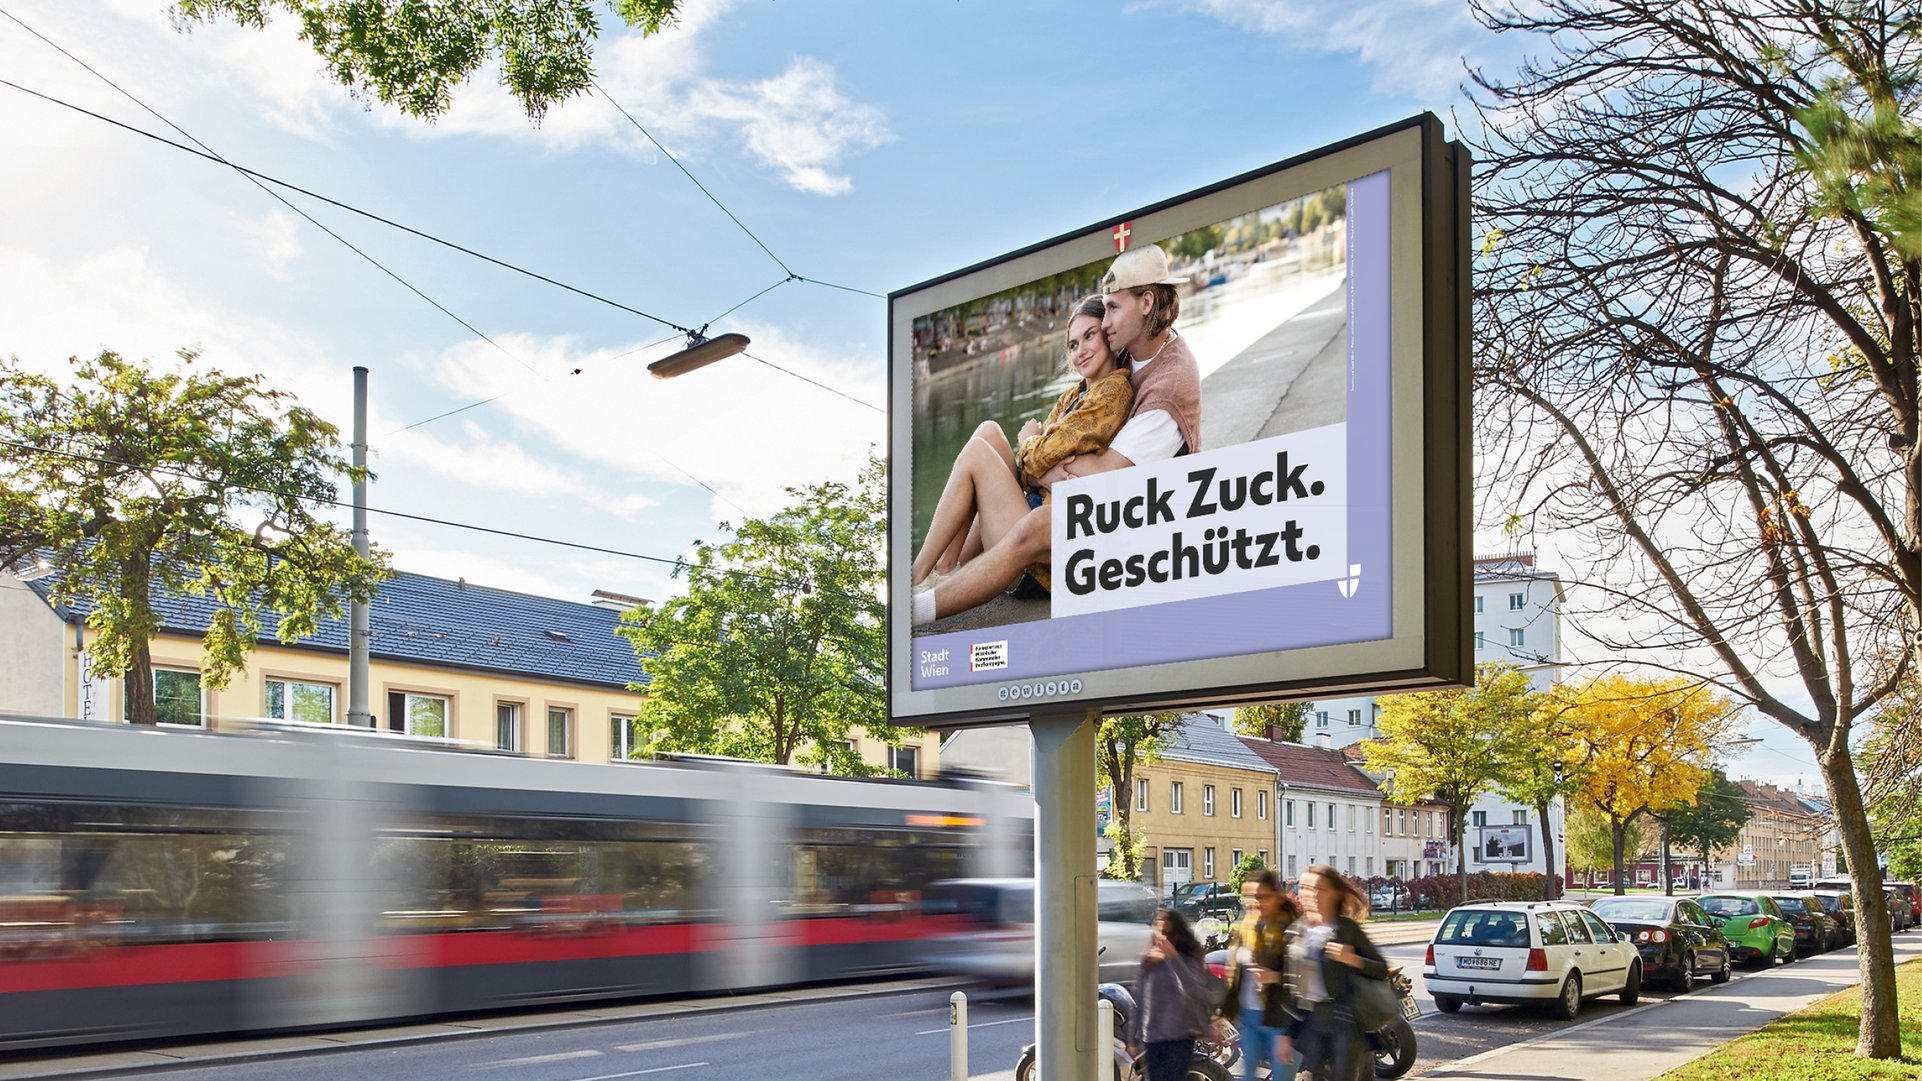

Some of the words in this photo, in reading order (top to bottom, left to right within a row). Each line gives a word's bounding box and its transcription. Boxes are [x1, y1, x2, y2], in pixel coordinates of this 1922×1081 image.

[1066, 477, 1175, 540] Ruck
[1186, 451, 1325, 518] Zuck.
[1065, 520, 1321, 596] Geschützt.
[921, 649, 949, 664] Stadt
[921, 664, 949, 678] Wien
[83, 653, 92, 720] HOTE
[999, 681, 1080, 698] gewista
